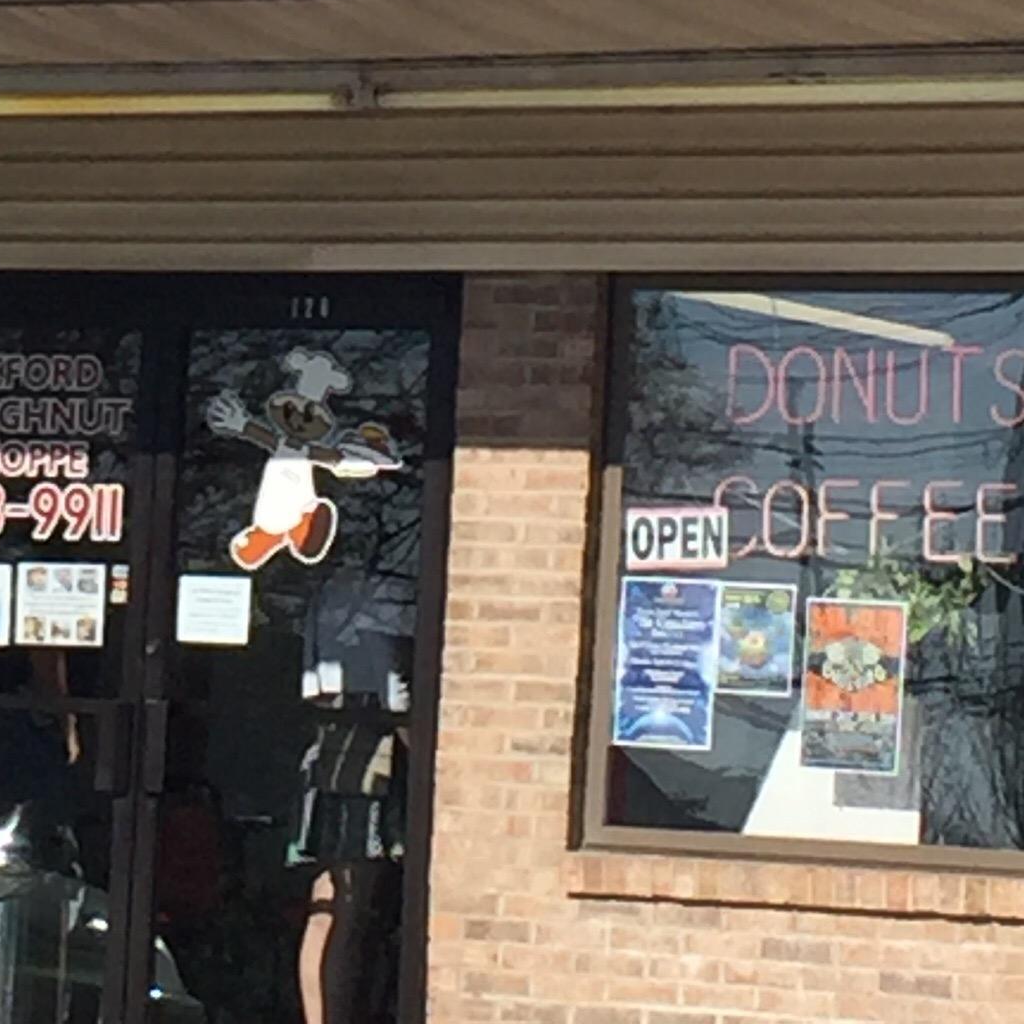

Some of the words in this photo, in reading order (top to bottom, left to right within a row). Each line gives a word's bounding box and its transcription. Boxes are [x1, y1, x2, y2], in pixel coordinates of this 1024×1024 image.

[726, 342, 1024, 427] DONUTS
[632, 516, 723, 560] OPEN
[714, 476, 1017, 564] COFFEE
